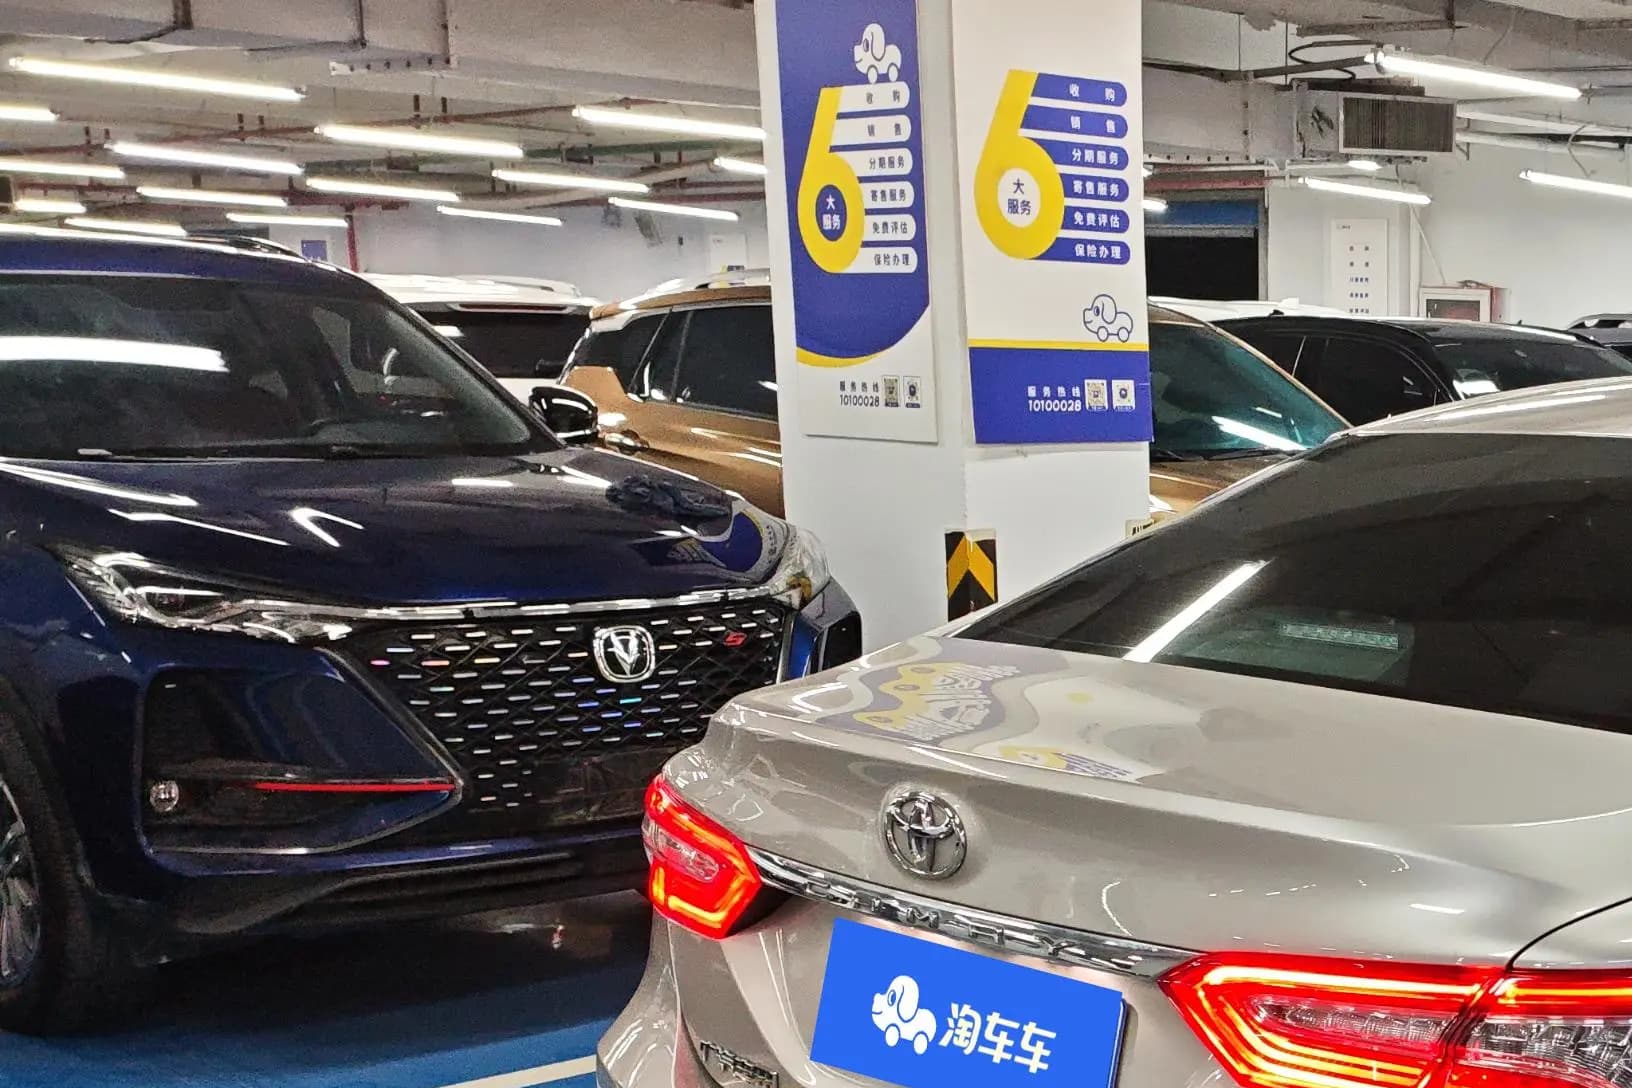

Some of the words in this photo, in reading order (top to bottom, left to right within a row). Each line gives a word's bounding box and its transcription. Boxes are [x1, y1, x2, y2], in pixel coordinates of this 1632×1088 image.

[869, 155, 905, 170] 分期服务
[1072, 148, 1119, 166] 分期服务
[1012, 178, 1025, 195] 大
[1073, 180, 1119, 197] 寄售服务
[826, 194, 836, 210] 大
[870, 189, 907, 203] 寄售服务
[1007, 198, 1032, 216] 服务
[822, 214, 841, 230] 服务
[1074, 211, 1120, 228] 免费评估
[872, 221, 908, 235] 免费评估
[1074, 243, 1121, 259] 保险办理
[874, 253, 910, 267] 保险办理
[839, 394, 880, 407] 10100028
[1028, 399, 1082, 412] 10100028
